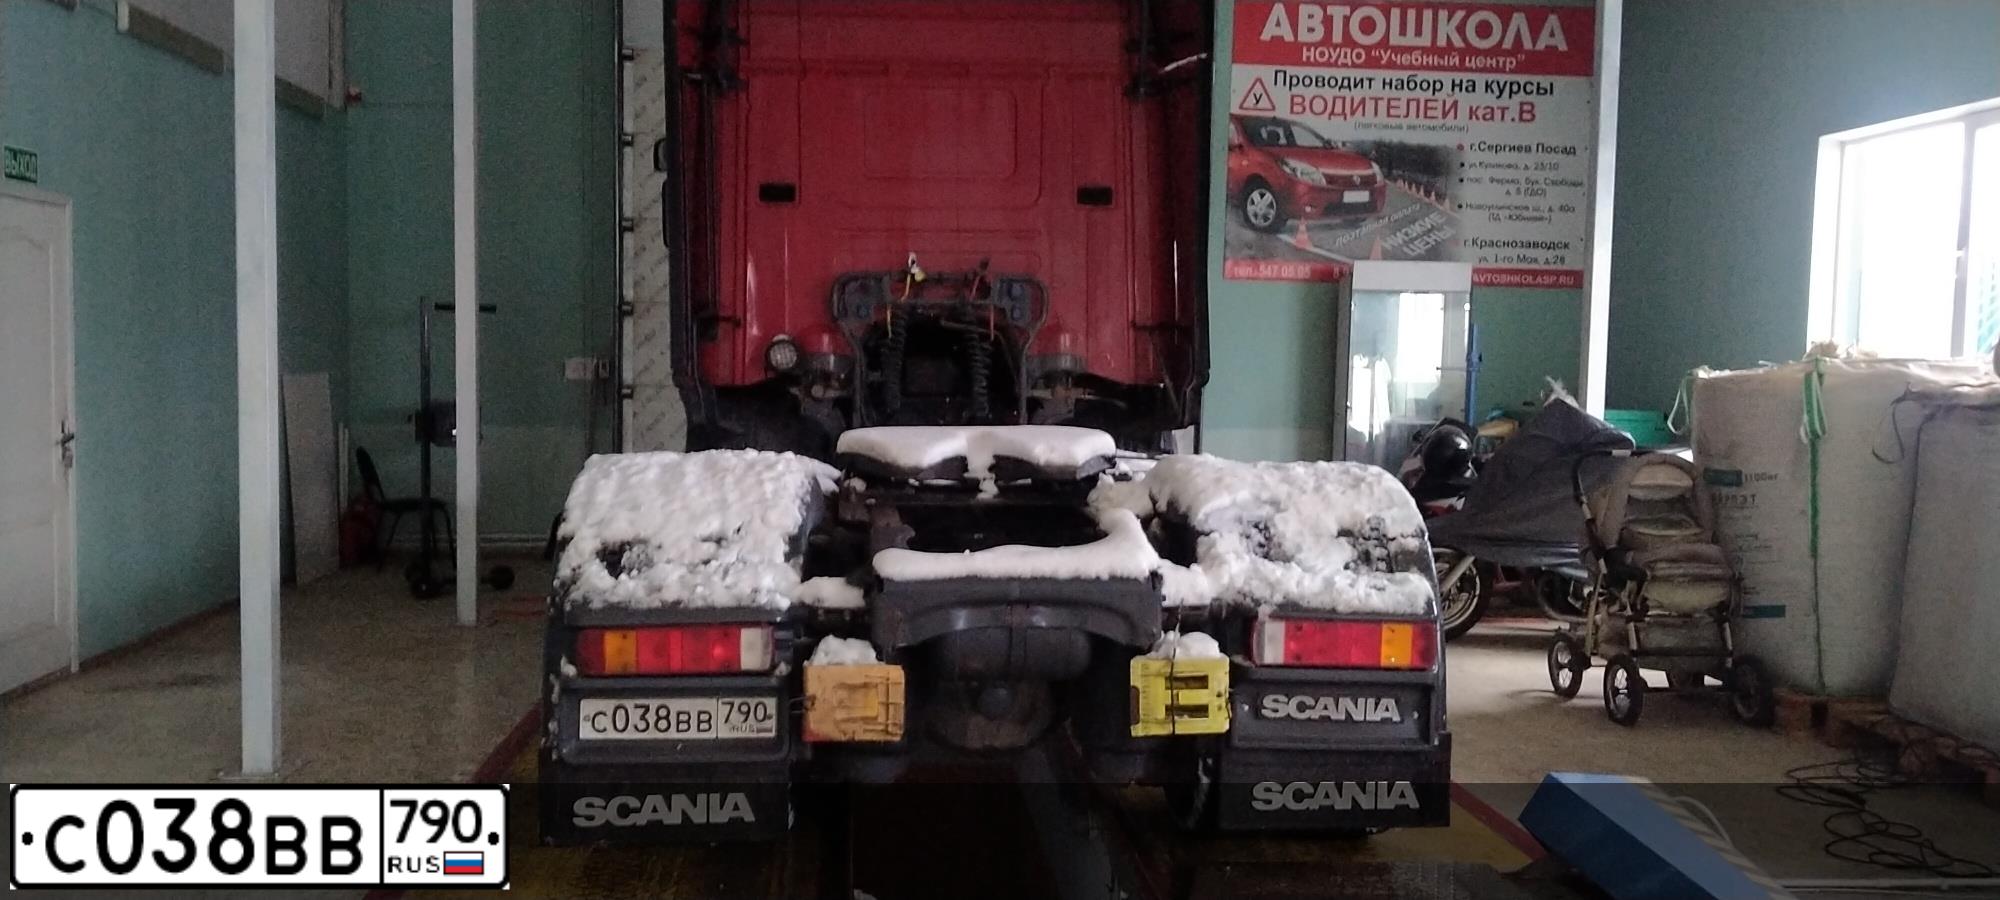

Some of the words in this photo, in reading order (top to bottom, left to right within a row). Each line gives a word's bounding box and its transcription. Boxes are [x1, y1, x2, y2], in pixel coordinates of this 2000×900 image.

[1259, 2, 1569, 52] АВТОШКОЛА
[1302, 46, 1366, 66] НОУДО
[1273, 69, 1375, 92] Проводит
[1382, 74, 1444, 96] набор
[1450, 78, 1477, 94] на
[1484, 79, 1554, 99] курсы
[1289, 93, 1459, 121] ВОДИТЕЛЕЙ
[1535, 142, 1577, 156] Посад
[5, 149, 37, 180] ВЫХОД
[1381, 210, 1447, 251] НИЗКИЕ
[1402, 225, 1457, 257] ЦЕНЫ
[721, 701, 768, 724] 790
[1261, 694, 1401, 722] SCANIA
[572, 792, 756, 827] SCANIA
[1251, 781, 1420, 811] SCANIA
